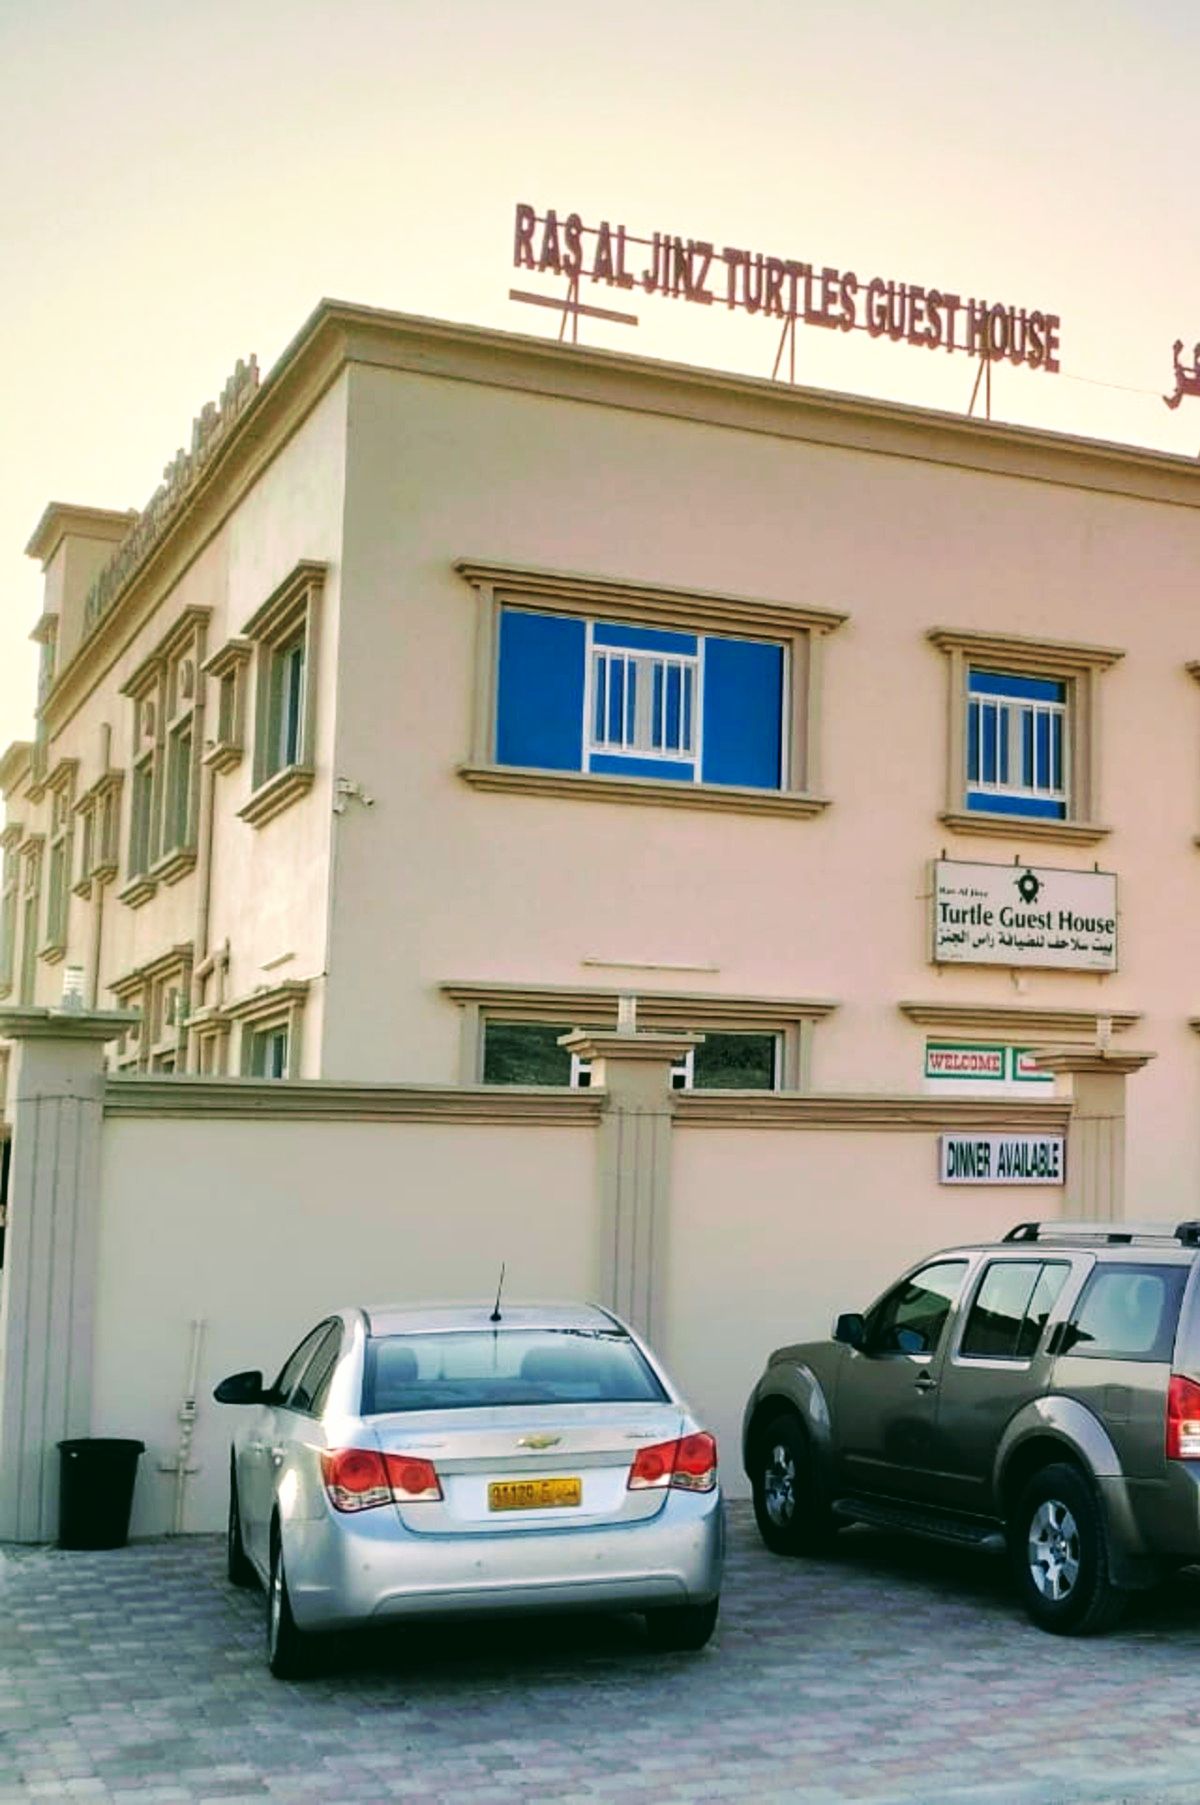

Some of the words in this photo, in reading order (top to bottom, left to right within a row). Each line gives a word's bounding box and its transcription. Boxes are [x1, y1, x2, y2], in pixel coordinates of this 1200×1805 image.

[514, 203, 583, 279] RAS
[592, 221, 632, 289] AL
[642, 232, 713, 305] JINZ
[723, 247, 857, 331] TURTLES
[866, 277, 960, 353] GUEST
[968, 298, 1060, 373] HOUSE
[939, 902, 993, 926] Turtle
[1000, 906, 1052, 930] Guest
[1059, 910, 1115, 933] House
[929, 1053, 1000, 1071] WELCOME
[947, 1141, 991, 1178] DINNER
[997, 1141, 1059, 1178] AVAILABLE
